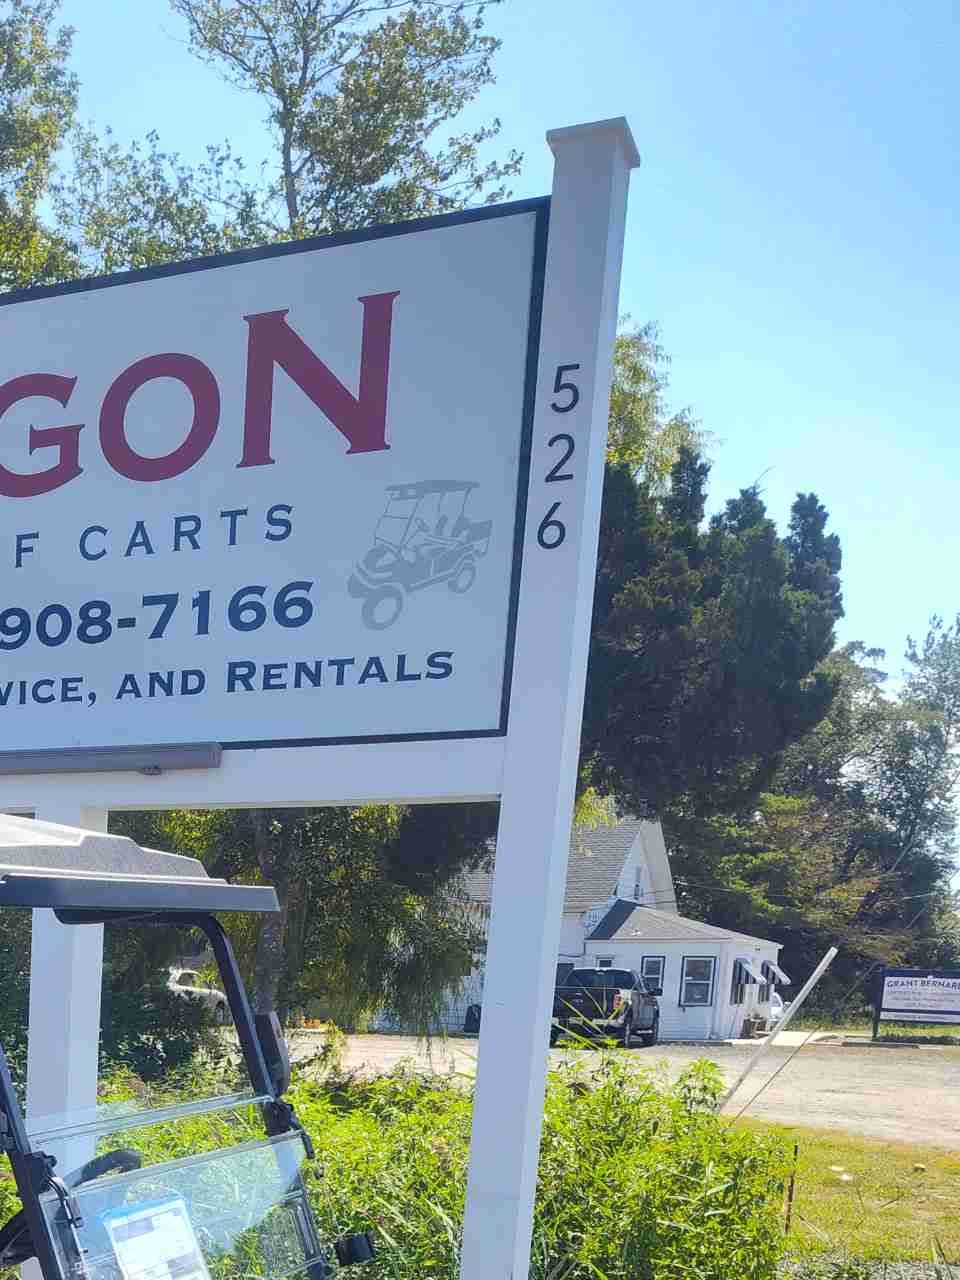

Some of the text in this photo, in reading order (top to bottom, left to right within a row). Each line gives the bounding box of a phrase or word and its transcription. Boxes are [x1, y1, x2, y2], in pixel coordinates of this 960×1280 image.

[79, 503, 295, 562] CARTS
[115, 669, 207, 700] AND
[226, 649, 455, 694] RENTALS
